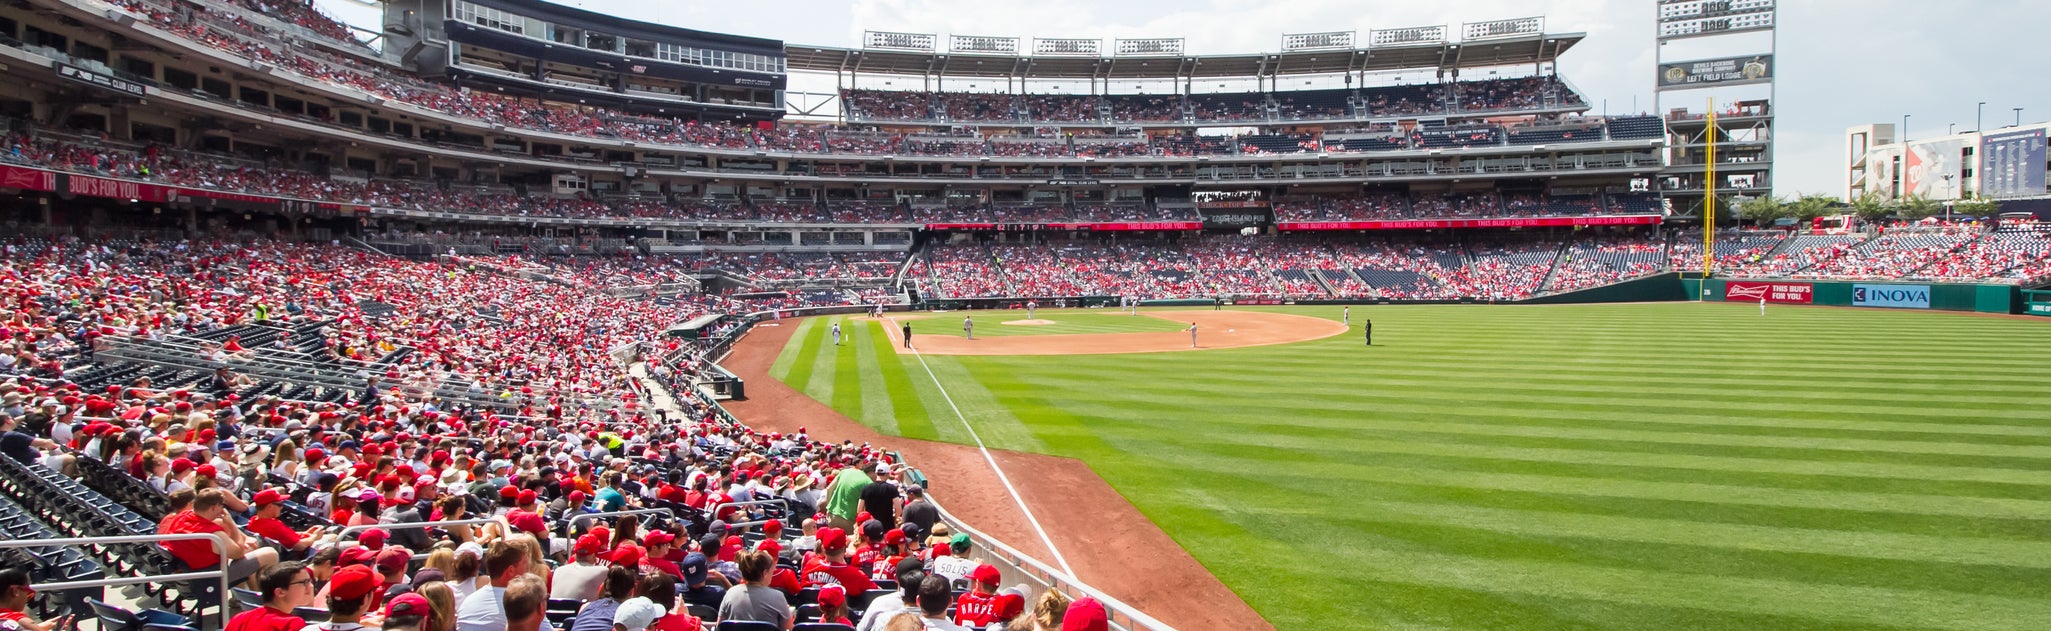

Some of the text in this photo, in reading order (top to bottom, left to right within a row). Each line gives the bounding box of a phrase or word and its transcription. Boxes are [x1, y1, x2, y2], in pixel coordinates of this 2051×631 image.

[1687, 75, 1701, 83] LEFT
[1703, 73, 1720, 81] FIELD
[112, 79, 127, 90] CLUB
[127, 83, 144, 95] LEVEL
[99, 180, 117, 197] FOR
[119, 182, 142, 199] YOU.
[1572, 217, 1638, 225] THIS BUD'S FOR YOU.
[1789, 285, 1811, 293] BUD'S
[1772, 292, 1803, 301] FOR YOU.
[1872, 289, 1928, 303] INOVA
[2032, 304, 2045, 312] HOME
[961, 603, 998, 618] HARPE
